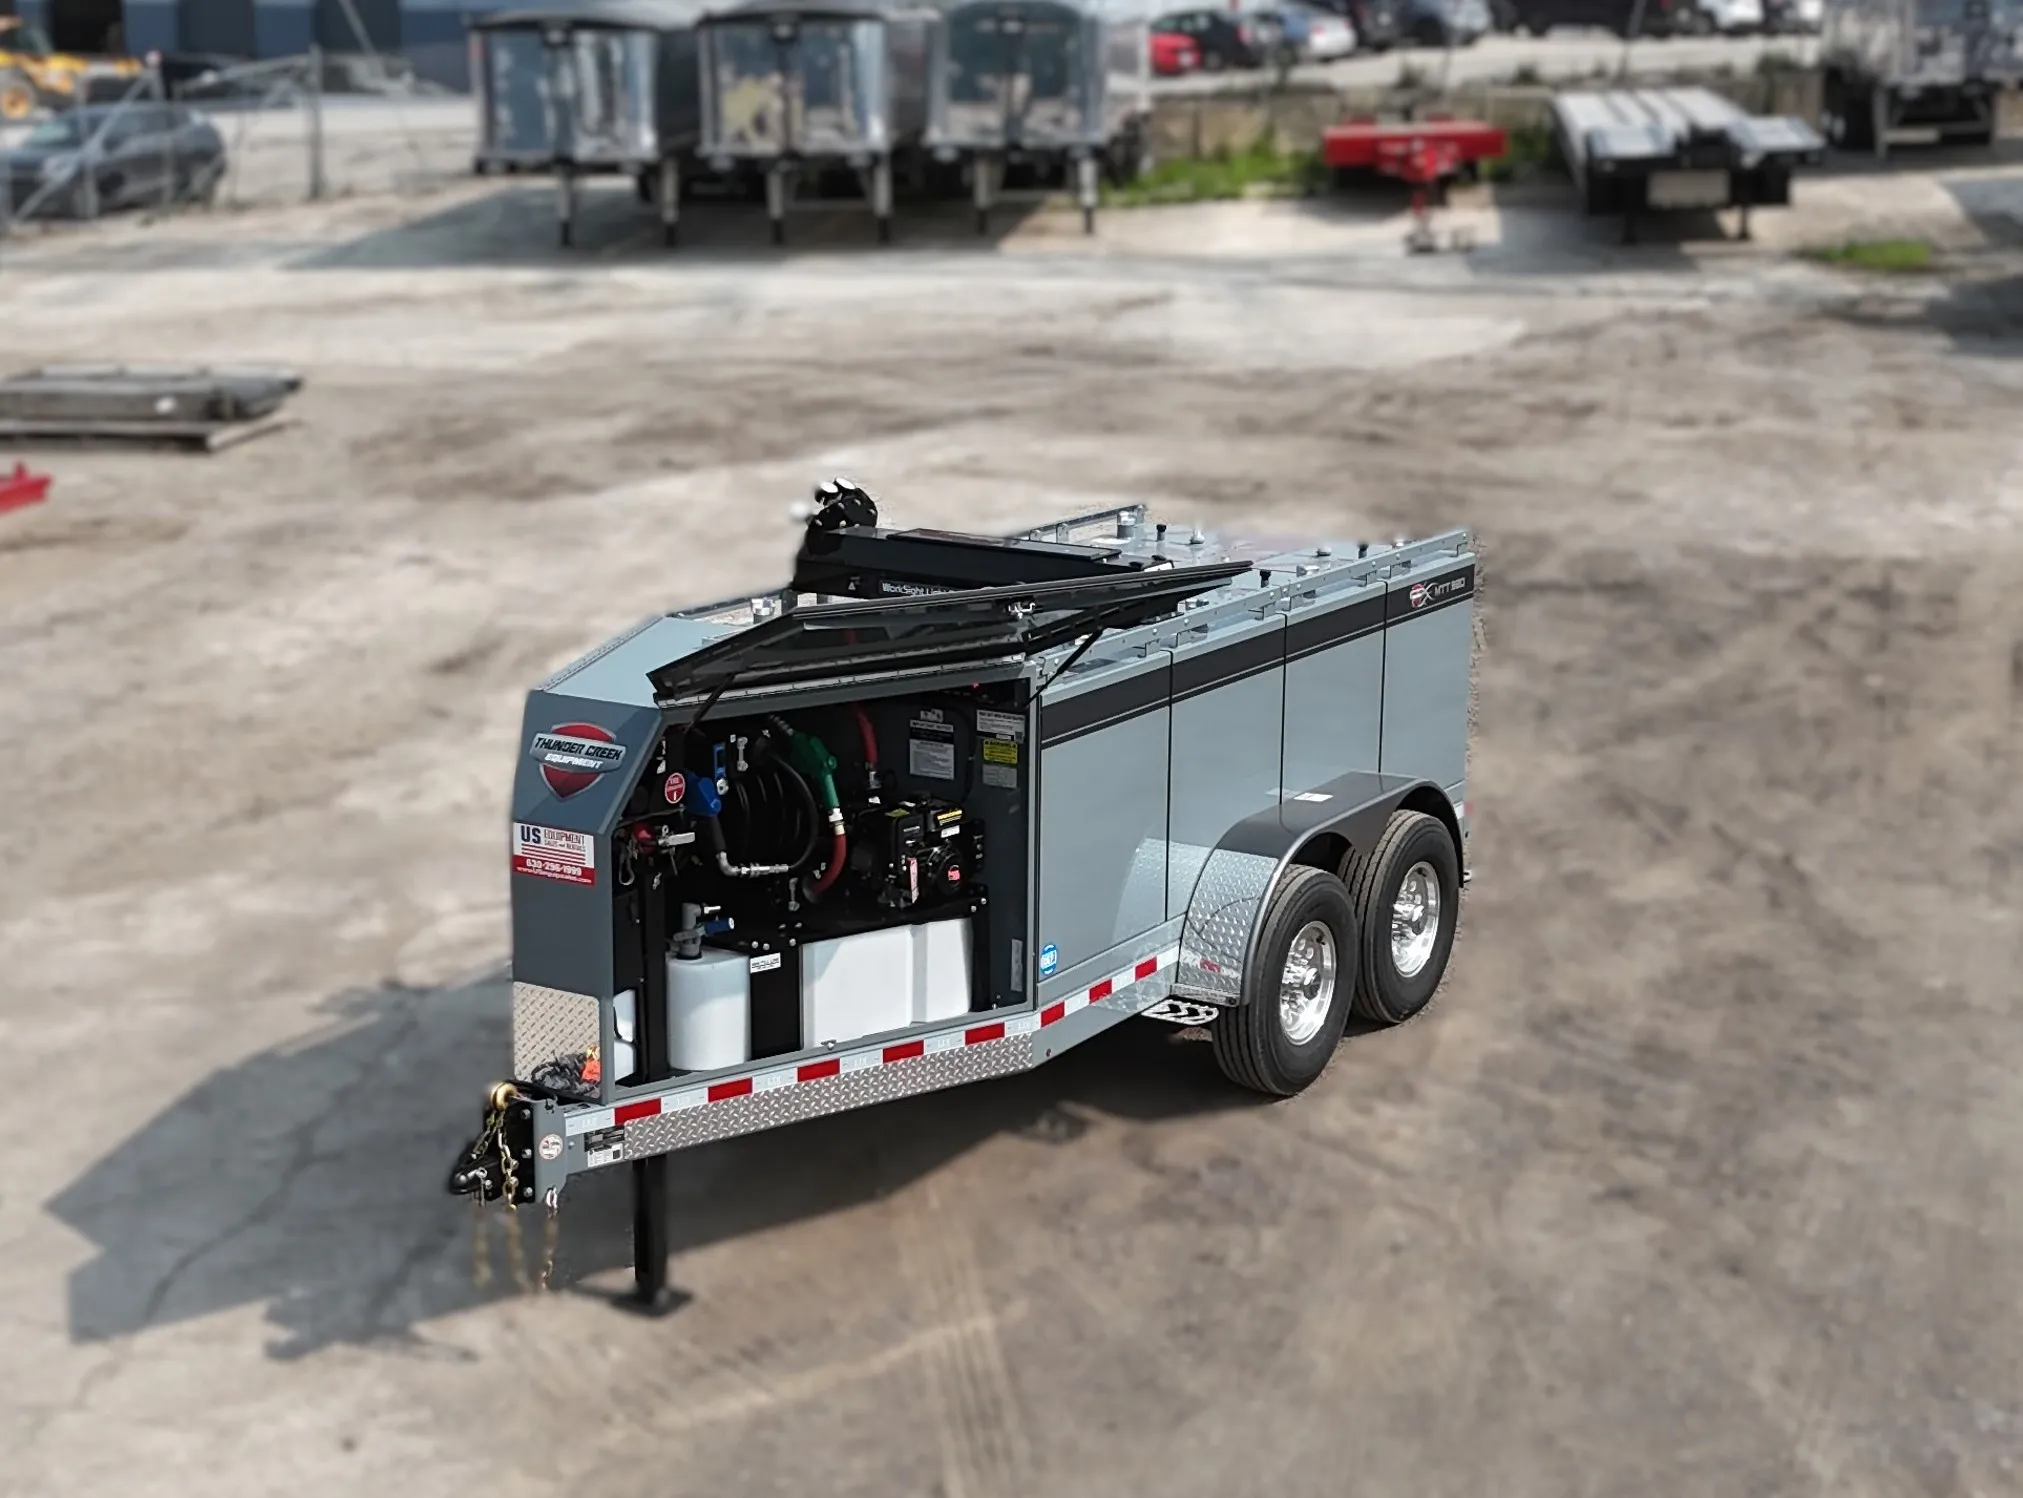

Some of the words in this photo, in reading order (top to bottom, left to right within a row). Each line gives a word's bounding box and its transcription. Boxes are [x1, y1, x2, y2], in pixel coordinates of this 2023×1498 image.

[534, 737, 585, 755] THUNDER
[585, 745, 622, 760] CREEK
[544, 753, 603, 768] EQUIPMENT
[521, 825, 541, 844] US
